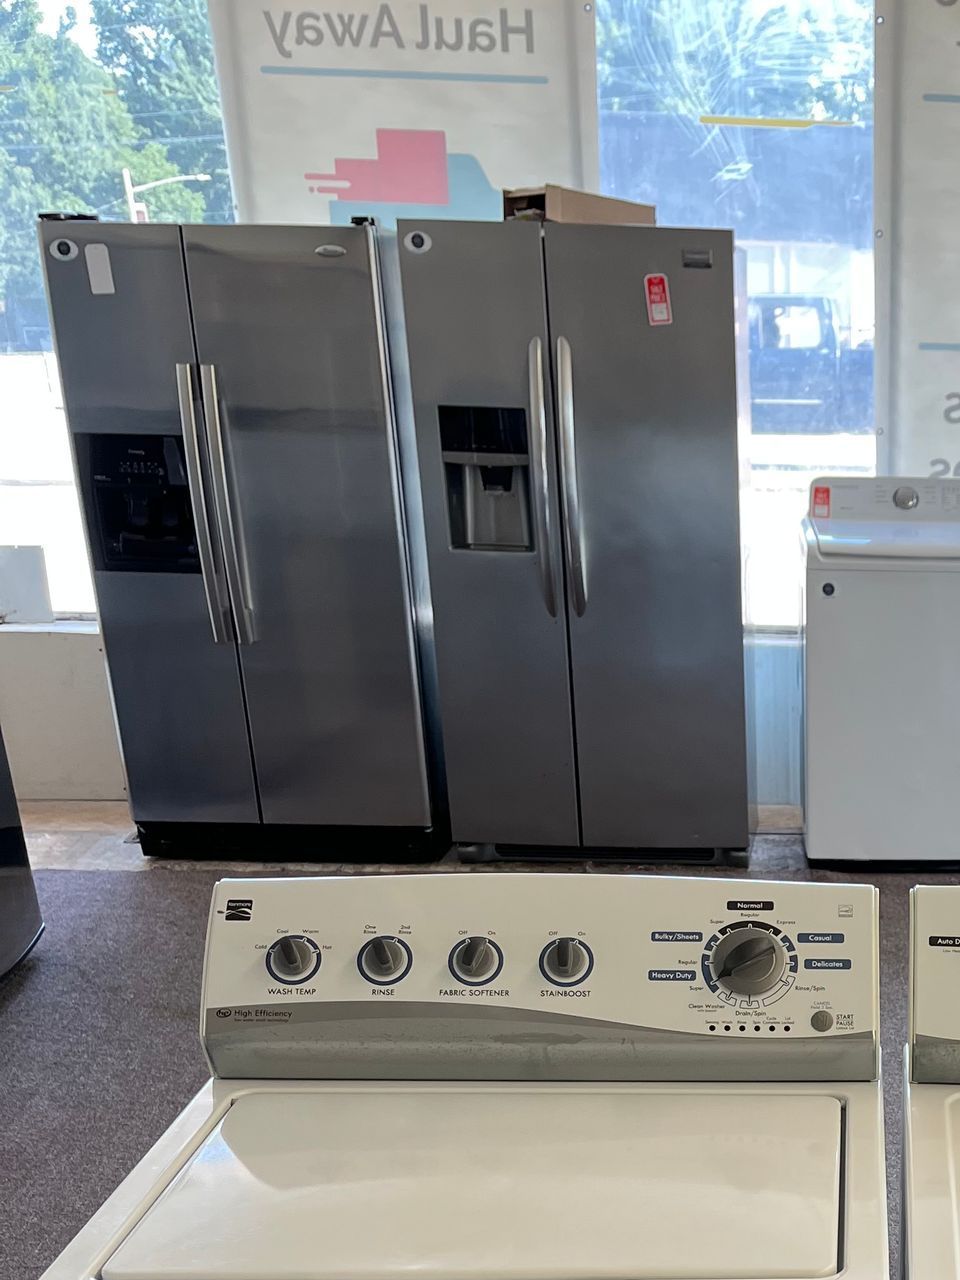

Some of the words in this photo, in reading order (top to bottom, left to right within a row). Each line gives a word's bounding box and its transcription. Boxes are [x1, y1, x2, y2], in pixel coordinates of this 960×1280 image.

[655, 933, 699, 941] Bulky/Sheets
[676, 972, 692, 980] Duty
[371, 988, 395, 996] RINSE
[439, 989, 467, 997] FABRIC
[468, 989, 510, 997] SOFTENER
[540, 990, 591, 998] STAINBOOST
[234, 1009, 253, 1018] High
[254, 1009, 293, 1018] Efficiency
